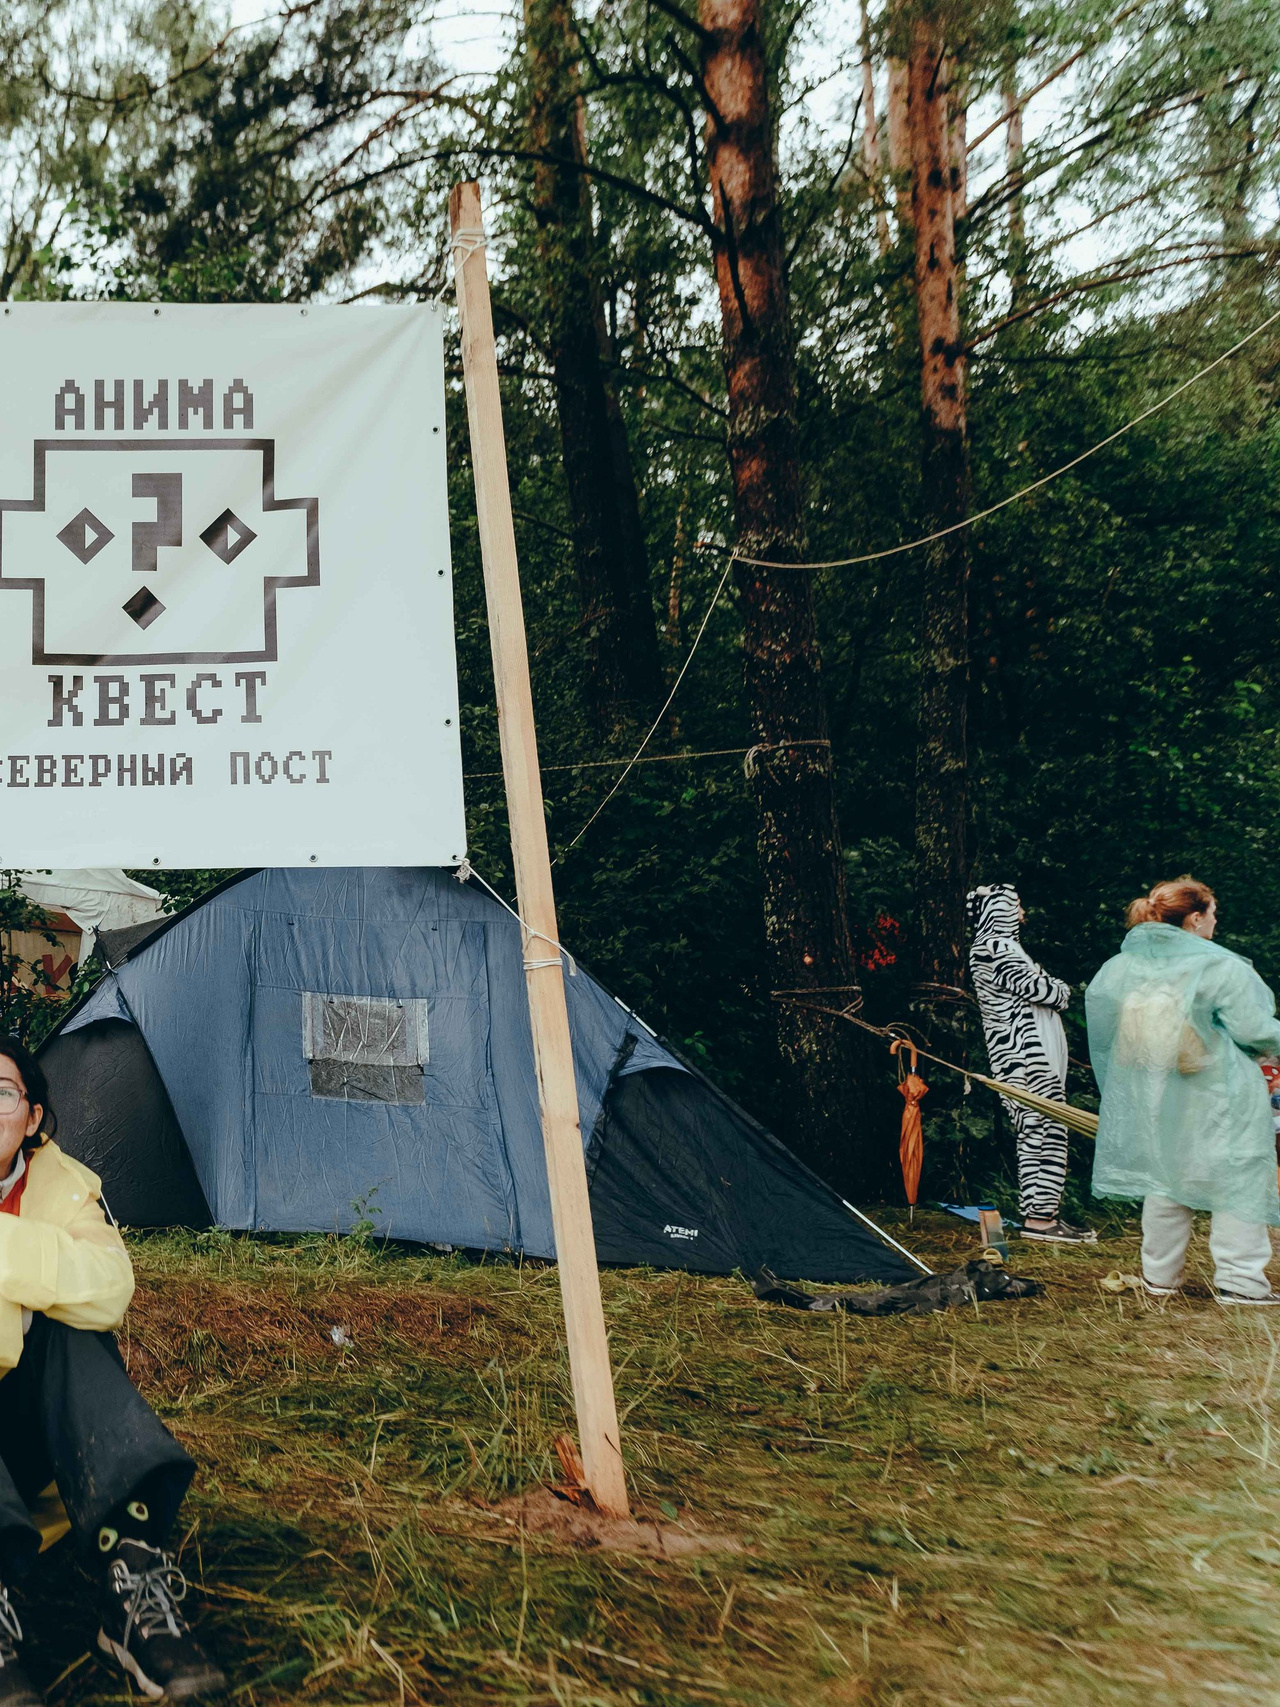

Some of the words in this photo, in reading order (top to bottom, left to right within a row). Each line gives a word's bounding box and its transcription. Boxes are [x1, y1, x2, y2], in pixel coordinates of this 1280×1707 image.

[54, 378, 254, 431] АНИМА
[47, 671, 267, 727] КВЕСТ
[230, 750, 333, 785] ПОСТ
